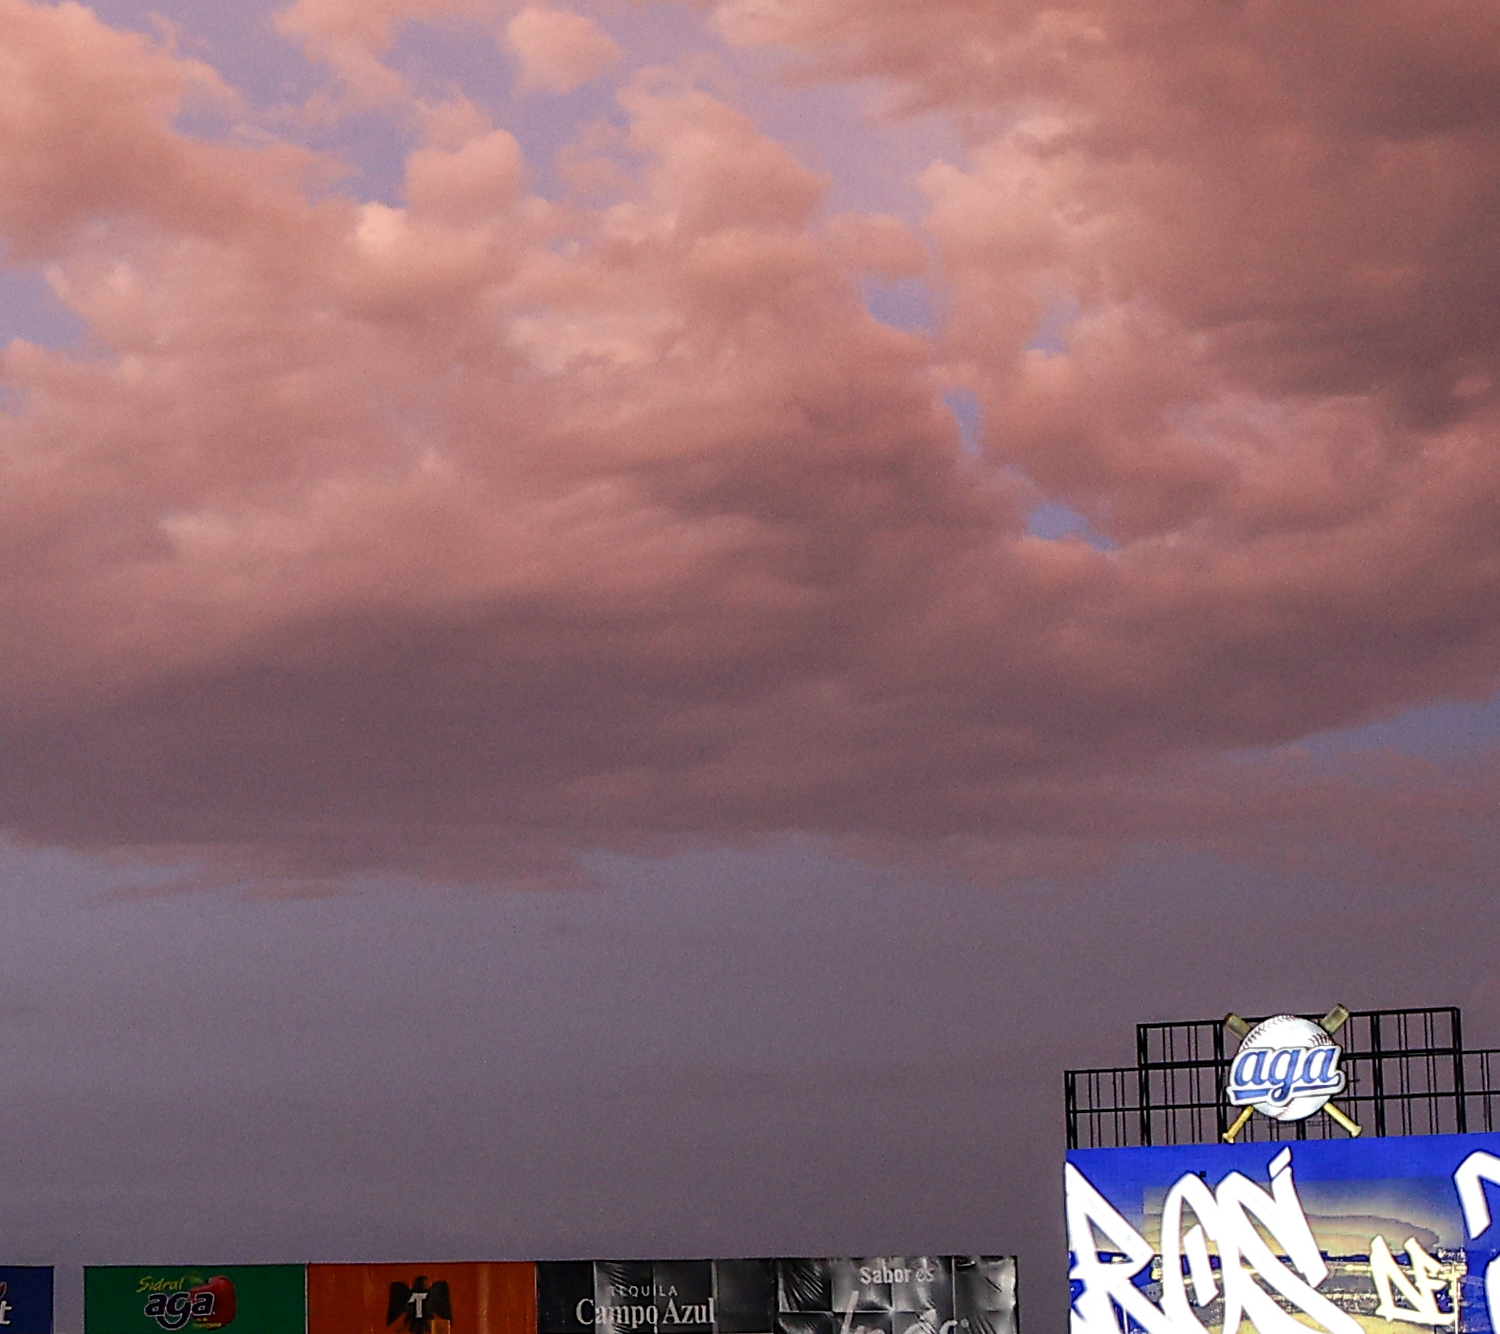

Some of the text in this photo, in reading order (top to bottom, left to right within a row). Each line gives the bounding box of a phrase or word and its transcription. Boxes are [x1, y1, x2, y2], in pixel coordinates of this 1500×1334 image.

[1235, 1046, 1338, 1102] aga
[136, 1275, 186, 1294] Sidral
[860, 1265, 912, 1284] Sabor
[610, 1285, 679, 1297] TEQUILA
[144, 1292, 216, 1331] aga
[575, 1297, 716, 1329] Campo Azul
